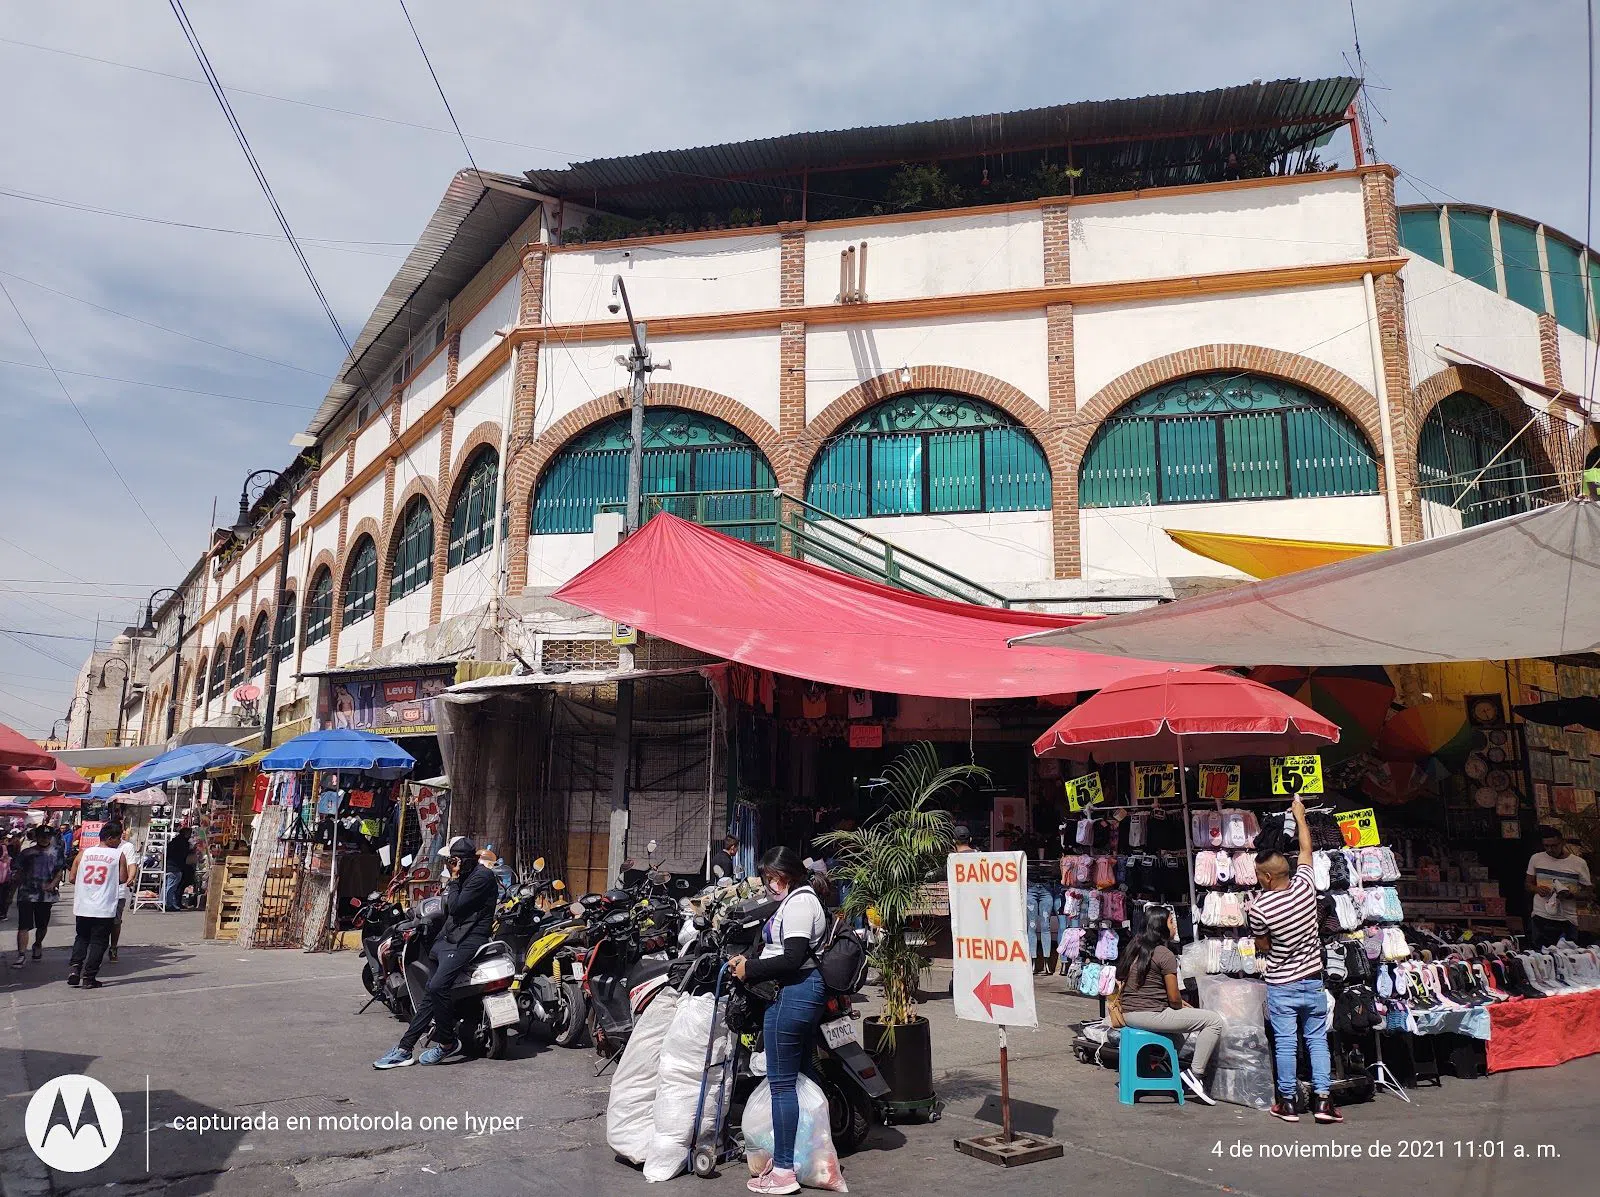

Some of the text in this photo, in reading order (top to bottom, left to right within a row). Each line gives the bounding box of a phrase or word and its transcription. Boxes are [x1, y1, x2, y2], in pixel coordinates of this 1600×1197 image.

[85, 854, 115, 865] JORDAN
[955, 858, 1018, 883] BAÑOS
[83, 864, 108, 886] 23
[979, 897, 992, 921] Y
[956, 937, 1027, 962] TIENDA
